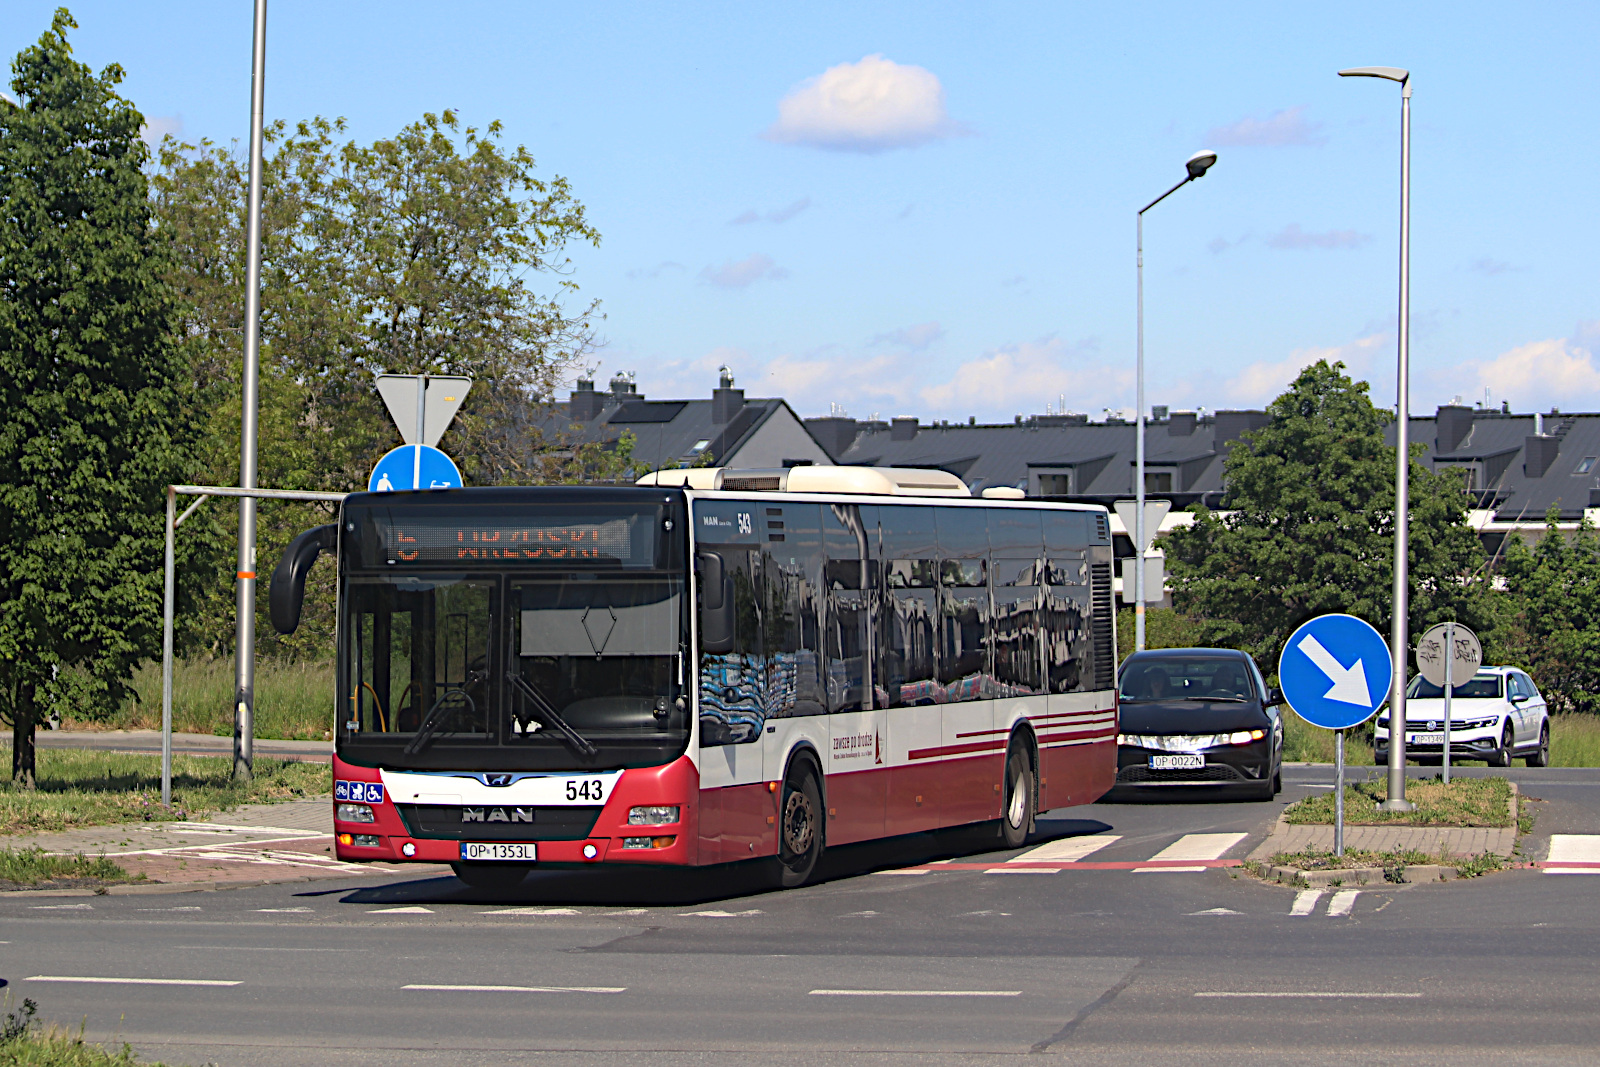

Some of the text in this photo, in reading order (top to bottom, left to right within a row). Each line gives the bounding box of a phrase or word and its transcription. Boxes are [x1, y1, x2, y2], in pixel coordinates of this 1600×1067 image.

[703, 516, 718, 526] MAN
[738, 513, 751, 534] 543
[833, 732, 872, 751] zawsze po drodze
[1155, 757, 1202, 766] OP 0022N
[566, 780, 602, 800] 543
[462, 808, 533, 822] MAN
[469, 844, 532, 859] OP 1353L
